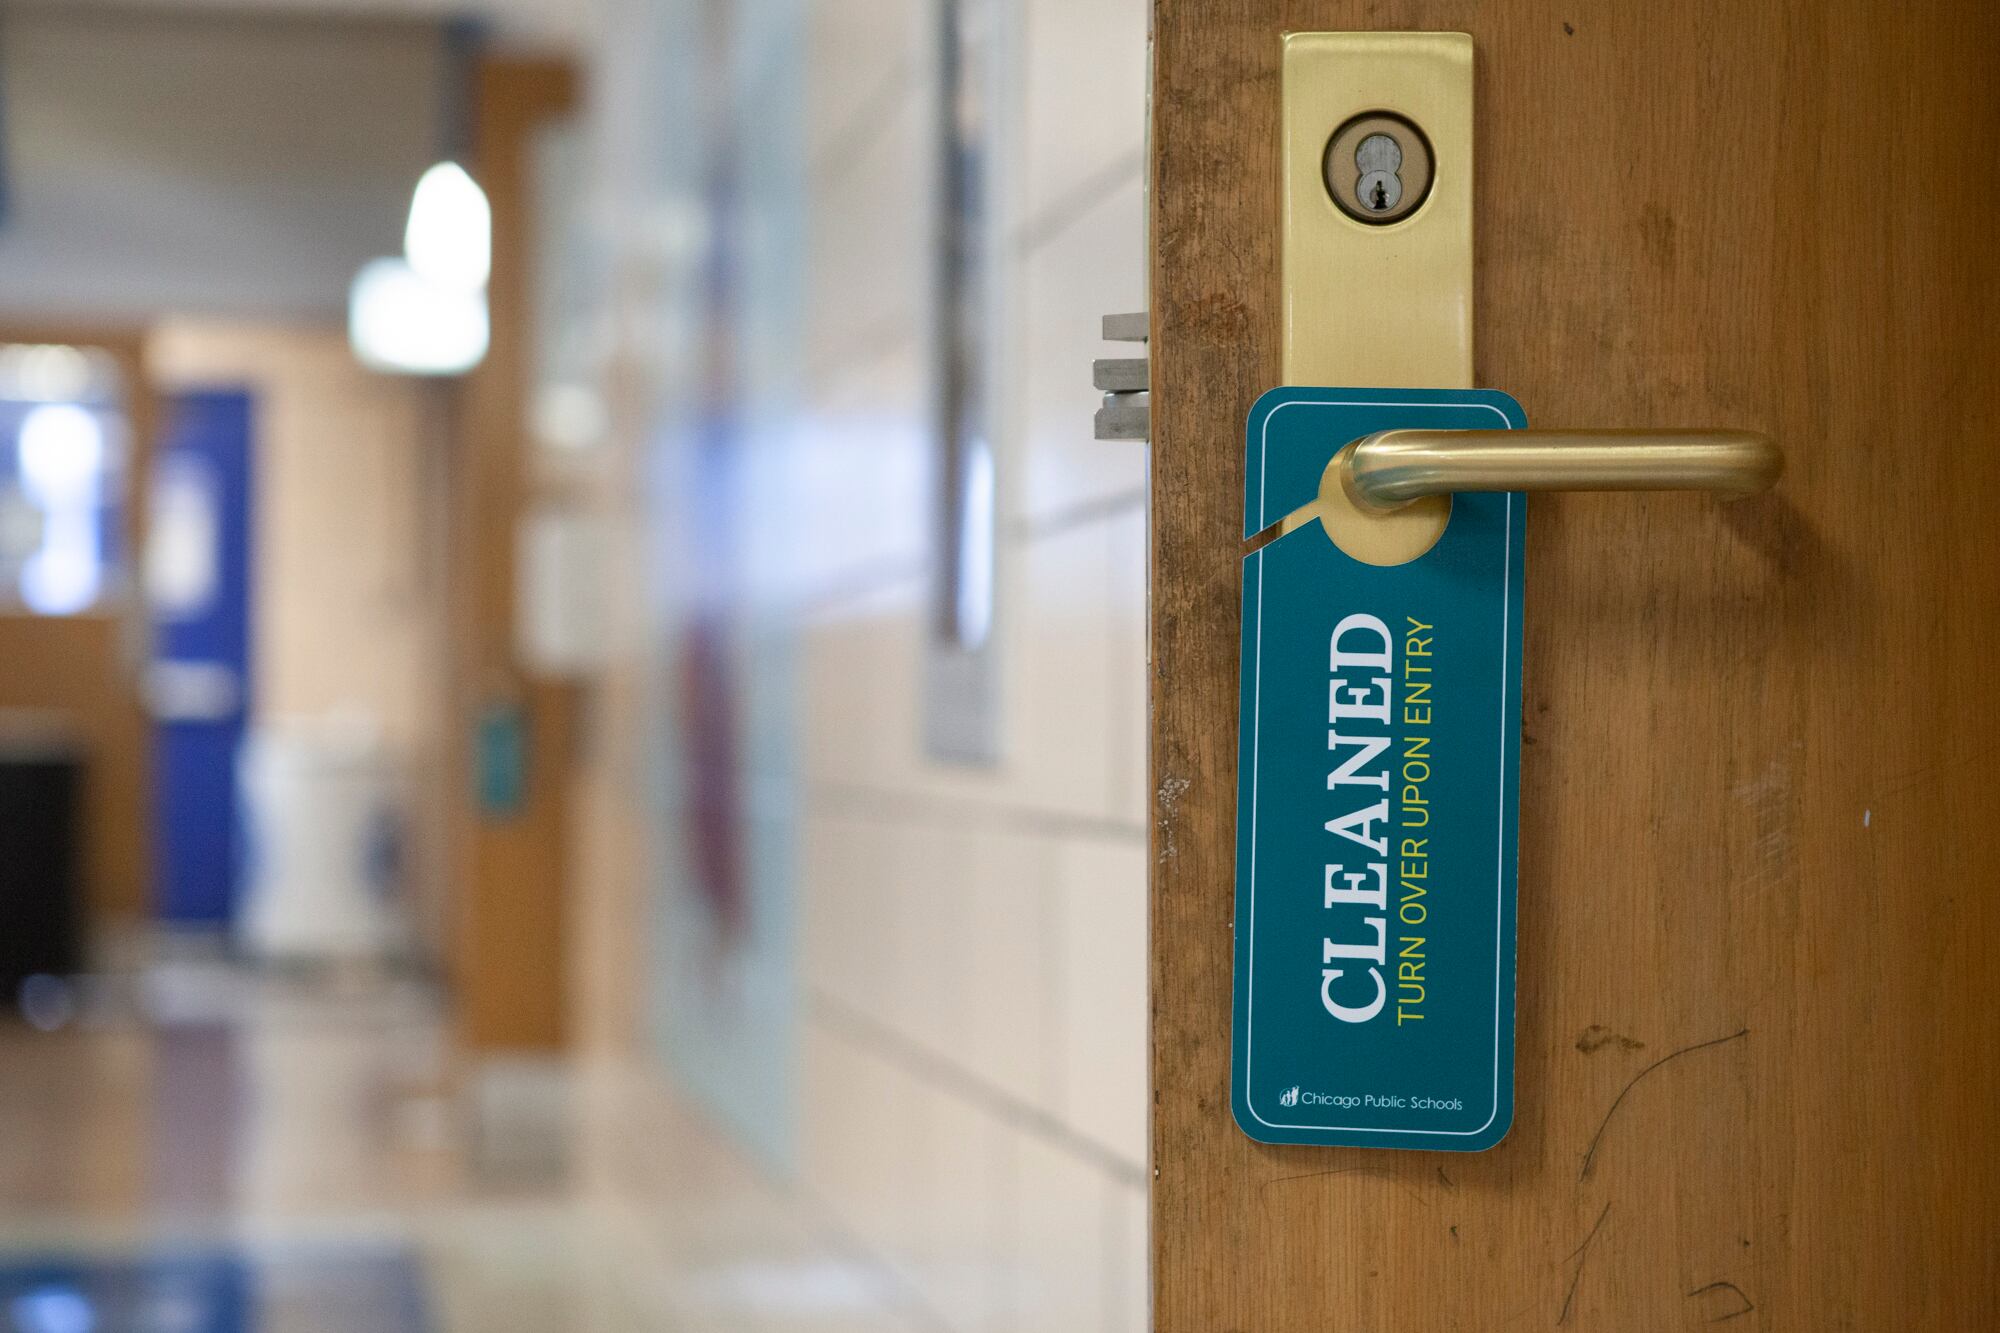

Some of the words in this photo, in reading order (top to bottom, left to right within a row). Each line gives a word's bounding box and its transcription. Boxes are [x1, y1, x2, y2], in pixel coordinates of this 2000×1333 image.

[1404, 616, 1433, 725] ENTRY
[1321, 613, 1393, 1023] CLEANED
[1402, 737, 1431, 827] UPON
[1400, 838, 1429, 925] OVER
[1397, 937, 1427, 1026] TURN
[1301, 1092, 1361, 1109] Chicago
[1364, 1094, 1406, 1108] Public
[1410, 1096, 1463, 1111] Schools
